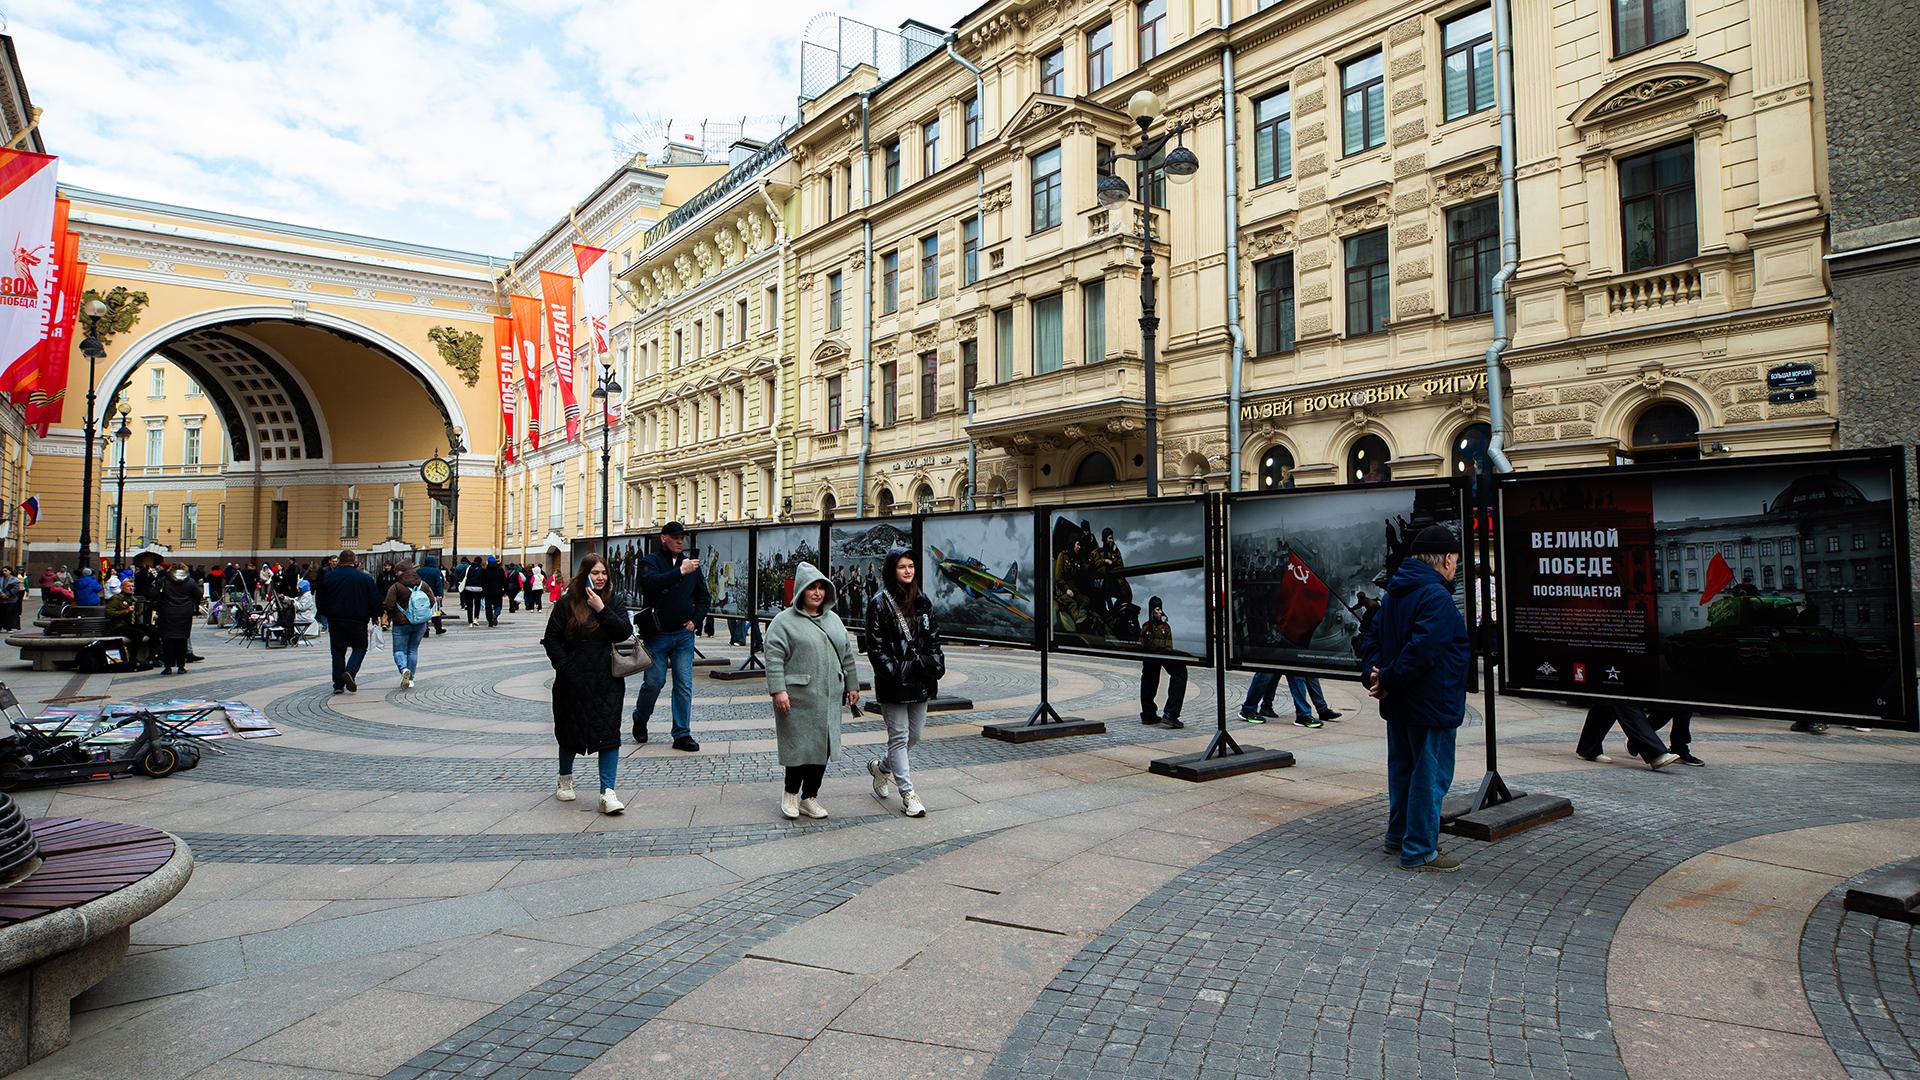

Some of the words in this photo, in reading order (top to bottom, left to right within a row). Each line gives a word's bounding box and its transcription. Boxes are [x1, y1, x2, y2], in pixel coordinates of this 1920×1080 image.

[1, 276, 25, 295] 80
[0, 296, 37, 308] ПОБЕДА!
[551, 304, 572, 383] ПОБЕДА!
[501, 345, 514, 414] ПОБЕДА!
[1240, 398, 1294, 421] МУЗЕЙ
[1303, 384, 1408, 412] ВОСКОВЫХ
[1422, 372, 1488, 396] ФИГУР
[1789, 392, 1795, 400] 6
[1531, 527, 1619, 549] ВЕЛИКОЙ
[1539, 557, 1613, 577] ПОБЕДЕ
[1533, 584, 1622, 599] ПОСВЯЩАЕТСЯ
